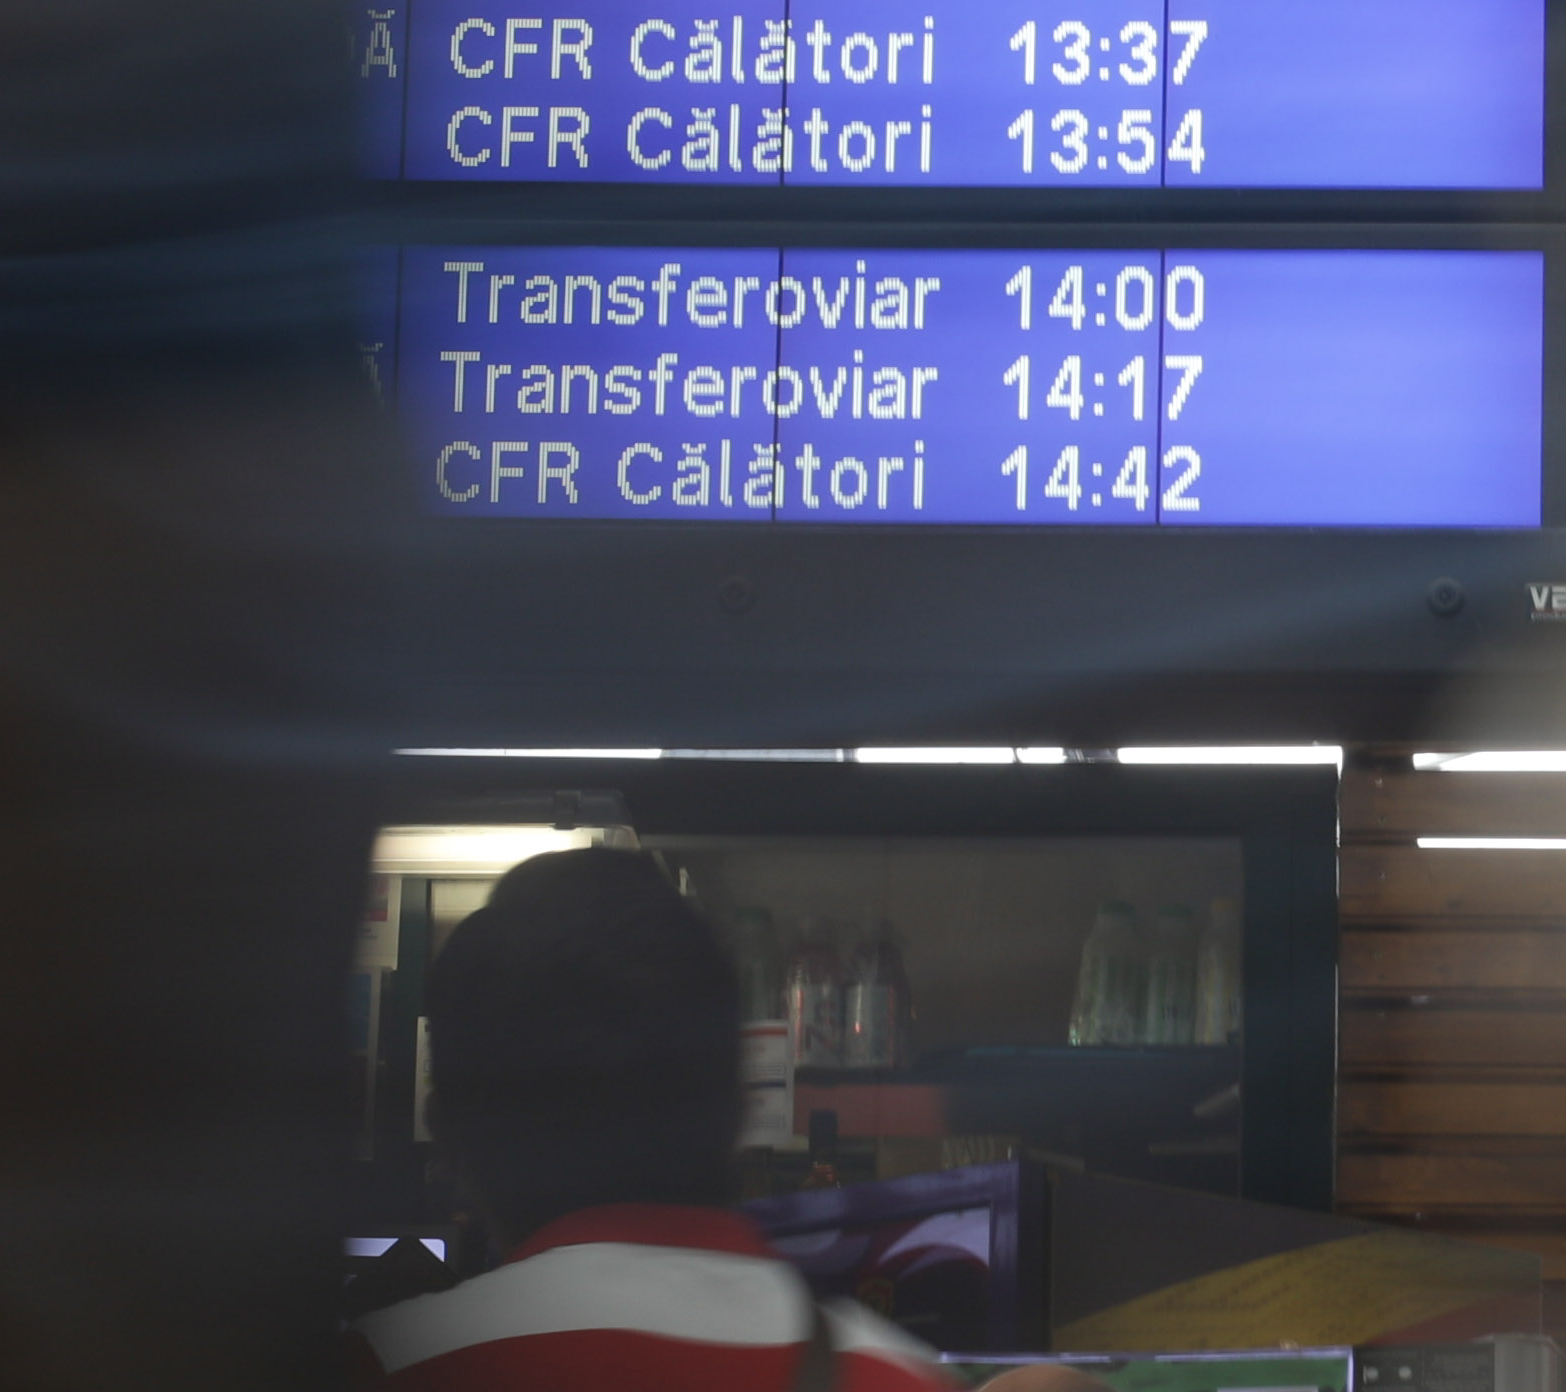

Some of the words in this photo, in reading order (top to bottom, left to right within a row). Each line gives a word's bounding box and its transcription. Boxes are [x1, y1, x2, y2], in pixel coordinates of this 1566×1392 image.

[448, 106, 589, 168] CFR
[627, 104, 931, 173] Călători
[1007, 108, 1205, 174] 13:54
[443, 260, 940, 330] Transferoviar
[1005, 265, 1204, 331] 14:00
